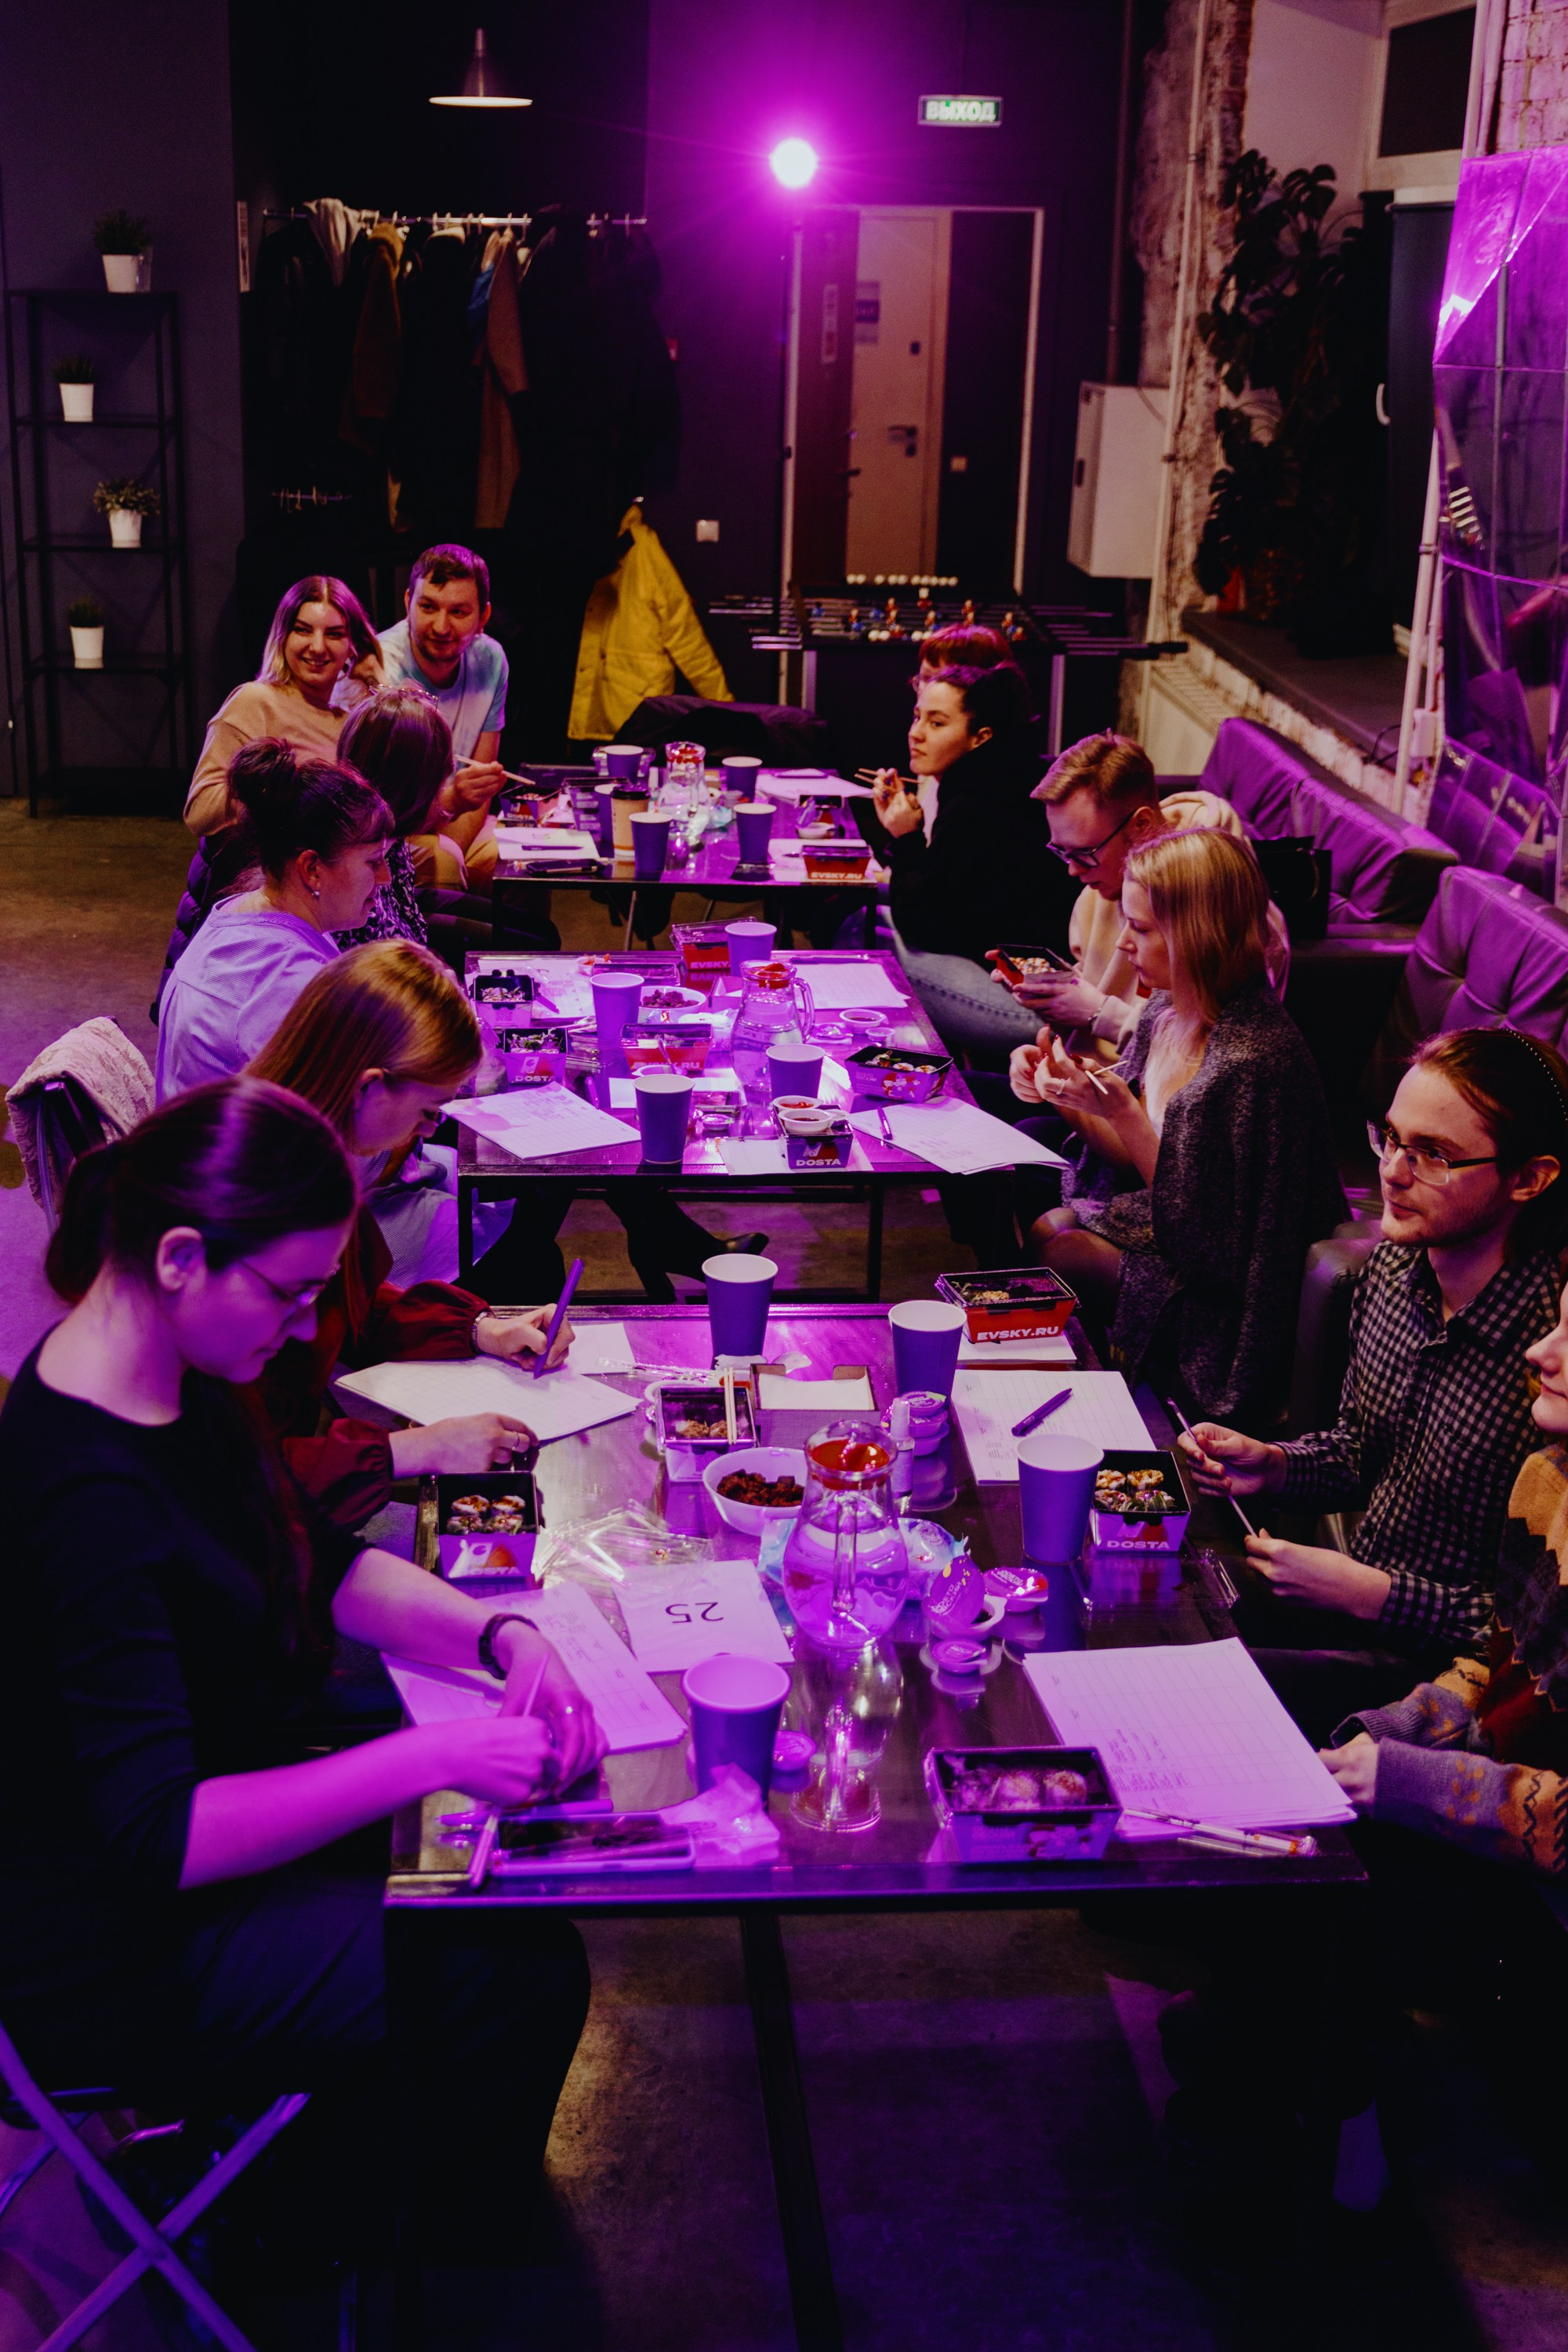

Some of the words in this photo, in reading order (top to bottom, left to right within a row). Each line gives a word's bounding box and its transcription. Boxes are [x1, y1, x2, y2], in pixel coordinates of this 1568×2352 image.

[927, 101, 996, 122] ВЫХОД
[977, 1326, 1059, 1341] EVSKY.RU
[1107, 1541, 1170, 1549] DOSTA
[467, 1566, 521, 1575] OSTA
[665, 1602, 724, 1624] 25
